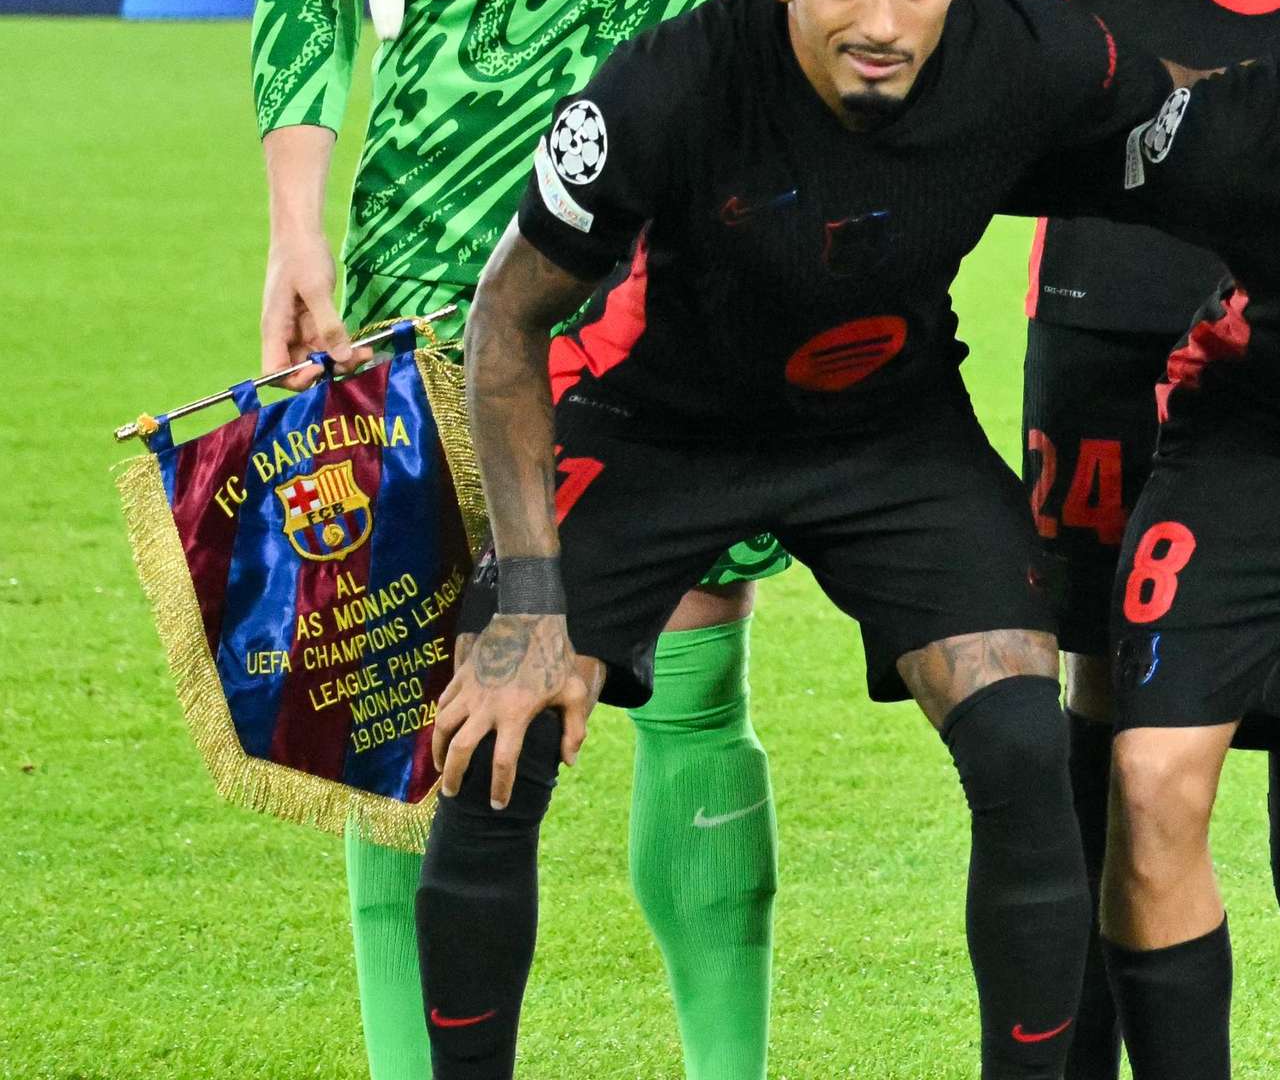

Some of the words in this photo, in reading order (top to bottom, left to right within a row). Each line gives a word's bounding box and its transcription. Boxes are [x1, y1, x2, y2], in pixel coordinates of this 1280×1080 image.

[214, 475, 248, 518] FC
[252, 415, 411, 483] BARCELONA
[1027, 428, 1128, 545] 24
[307, 503, 345, 524] FCB
[297, 612, 324, 640] AS
[333, 573, 419, 632] MONACO
[336, 571, 366, 599] AL
[1122, 520, 1197, 624] 8
[246, 651, 292, 675] UEFA
[303, 617, 409, 670] CHAMPIONS
[411, 568, 465, 628] LEAGUE
[308, 663, 384, 711] LEAGUE
[388, 637, 449, 679] PHASE
[350, 677, 423, 725] MONACO
